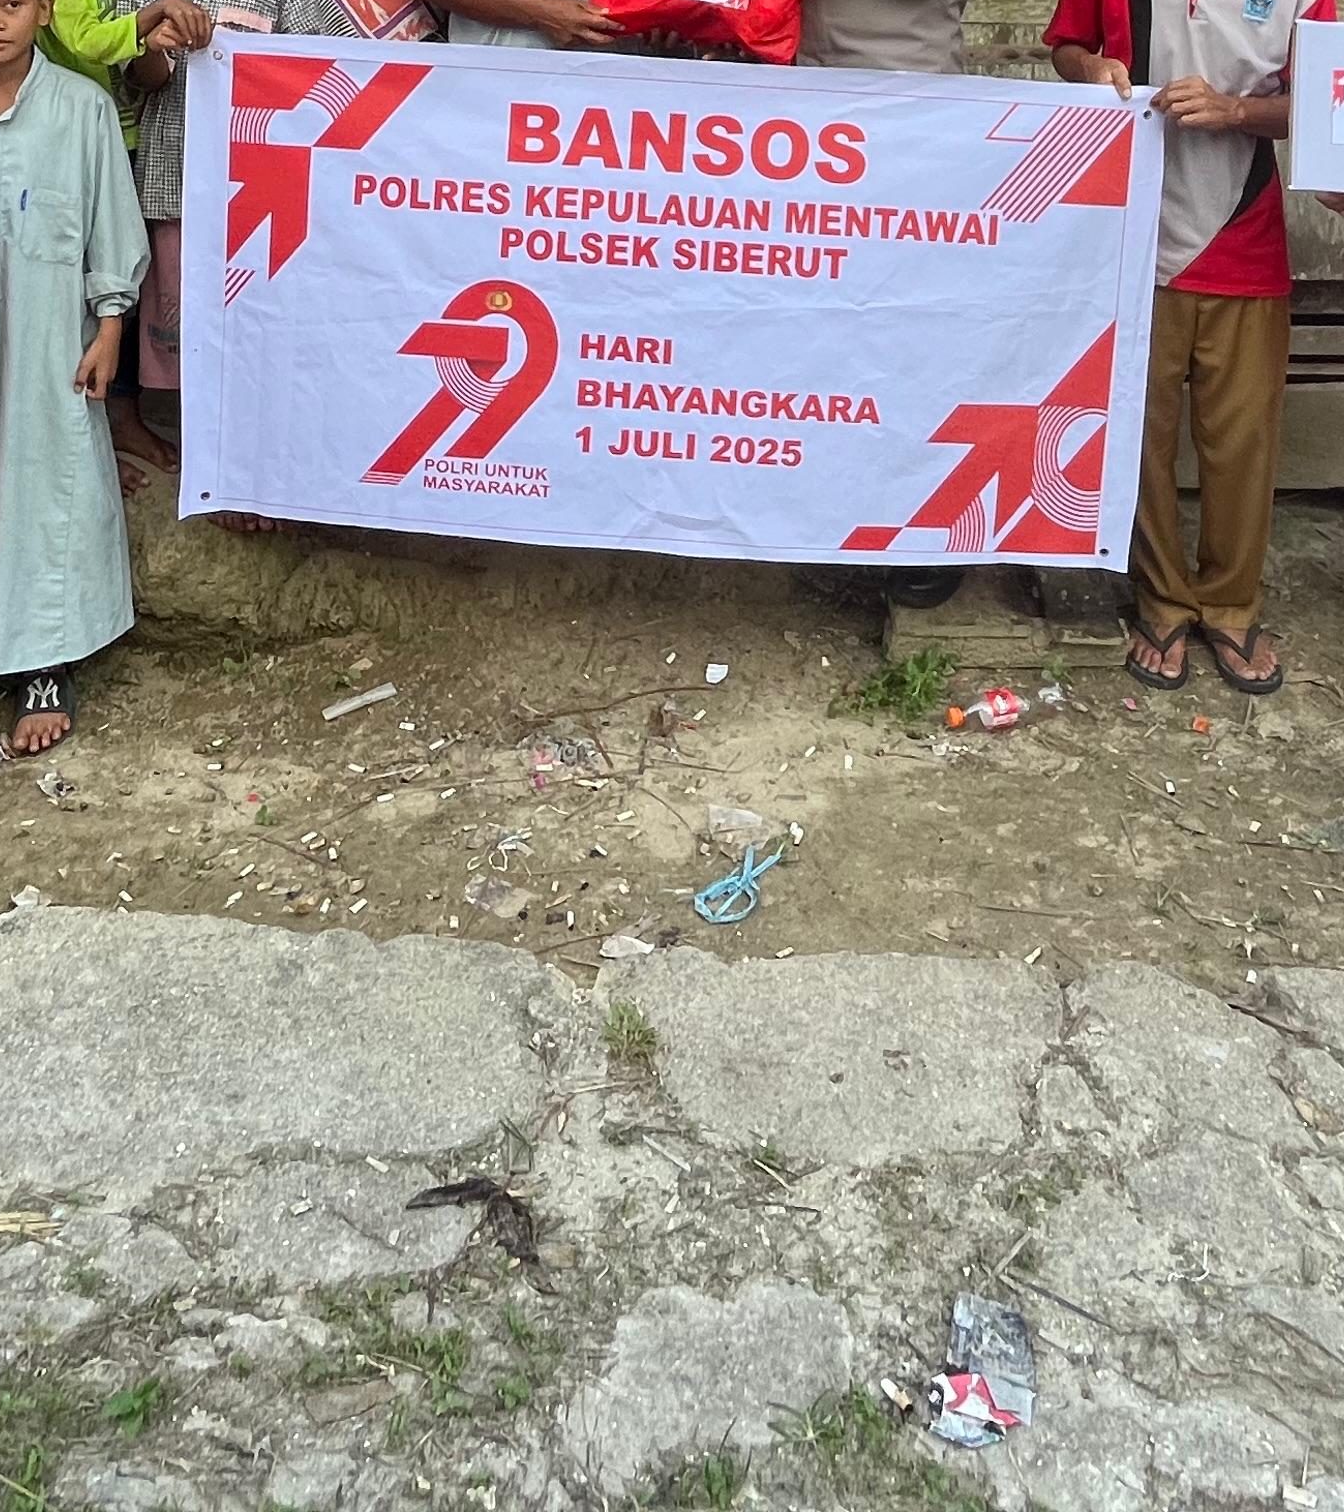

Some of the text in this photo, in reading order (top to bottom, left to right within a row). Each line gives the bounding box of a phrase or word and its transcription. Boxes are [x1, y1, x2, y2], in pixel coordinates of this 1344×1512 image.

[506, 102, 867, 185] BANSOS
[353, 174, 1000, 246] POLRES KEPULAUAN MENTAWAI
[499, 227, 848, 280] POLSEK SIBERUT
[579, 333, 673, 365] HARI
[576, 379, 881, 425] BHAYANGKARA
[574, 426, 803, 467] 1 JULI 2025
[423, 458, 549, 481] POLRI UNTUK
[423, 475, 551, 498] MASYARAKAT
